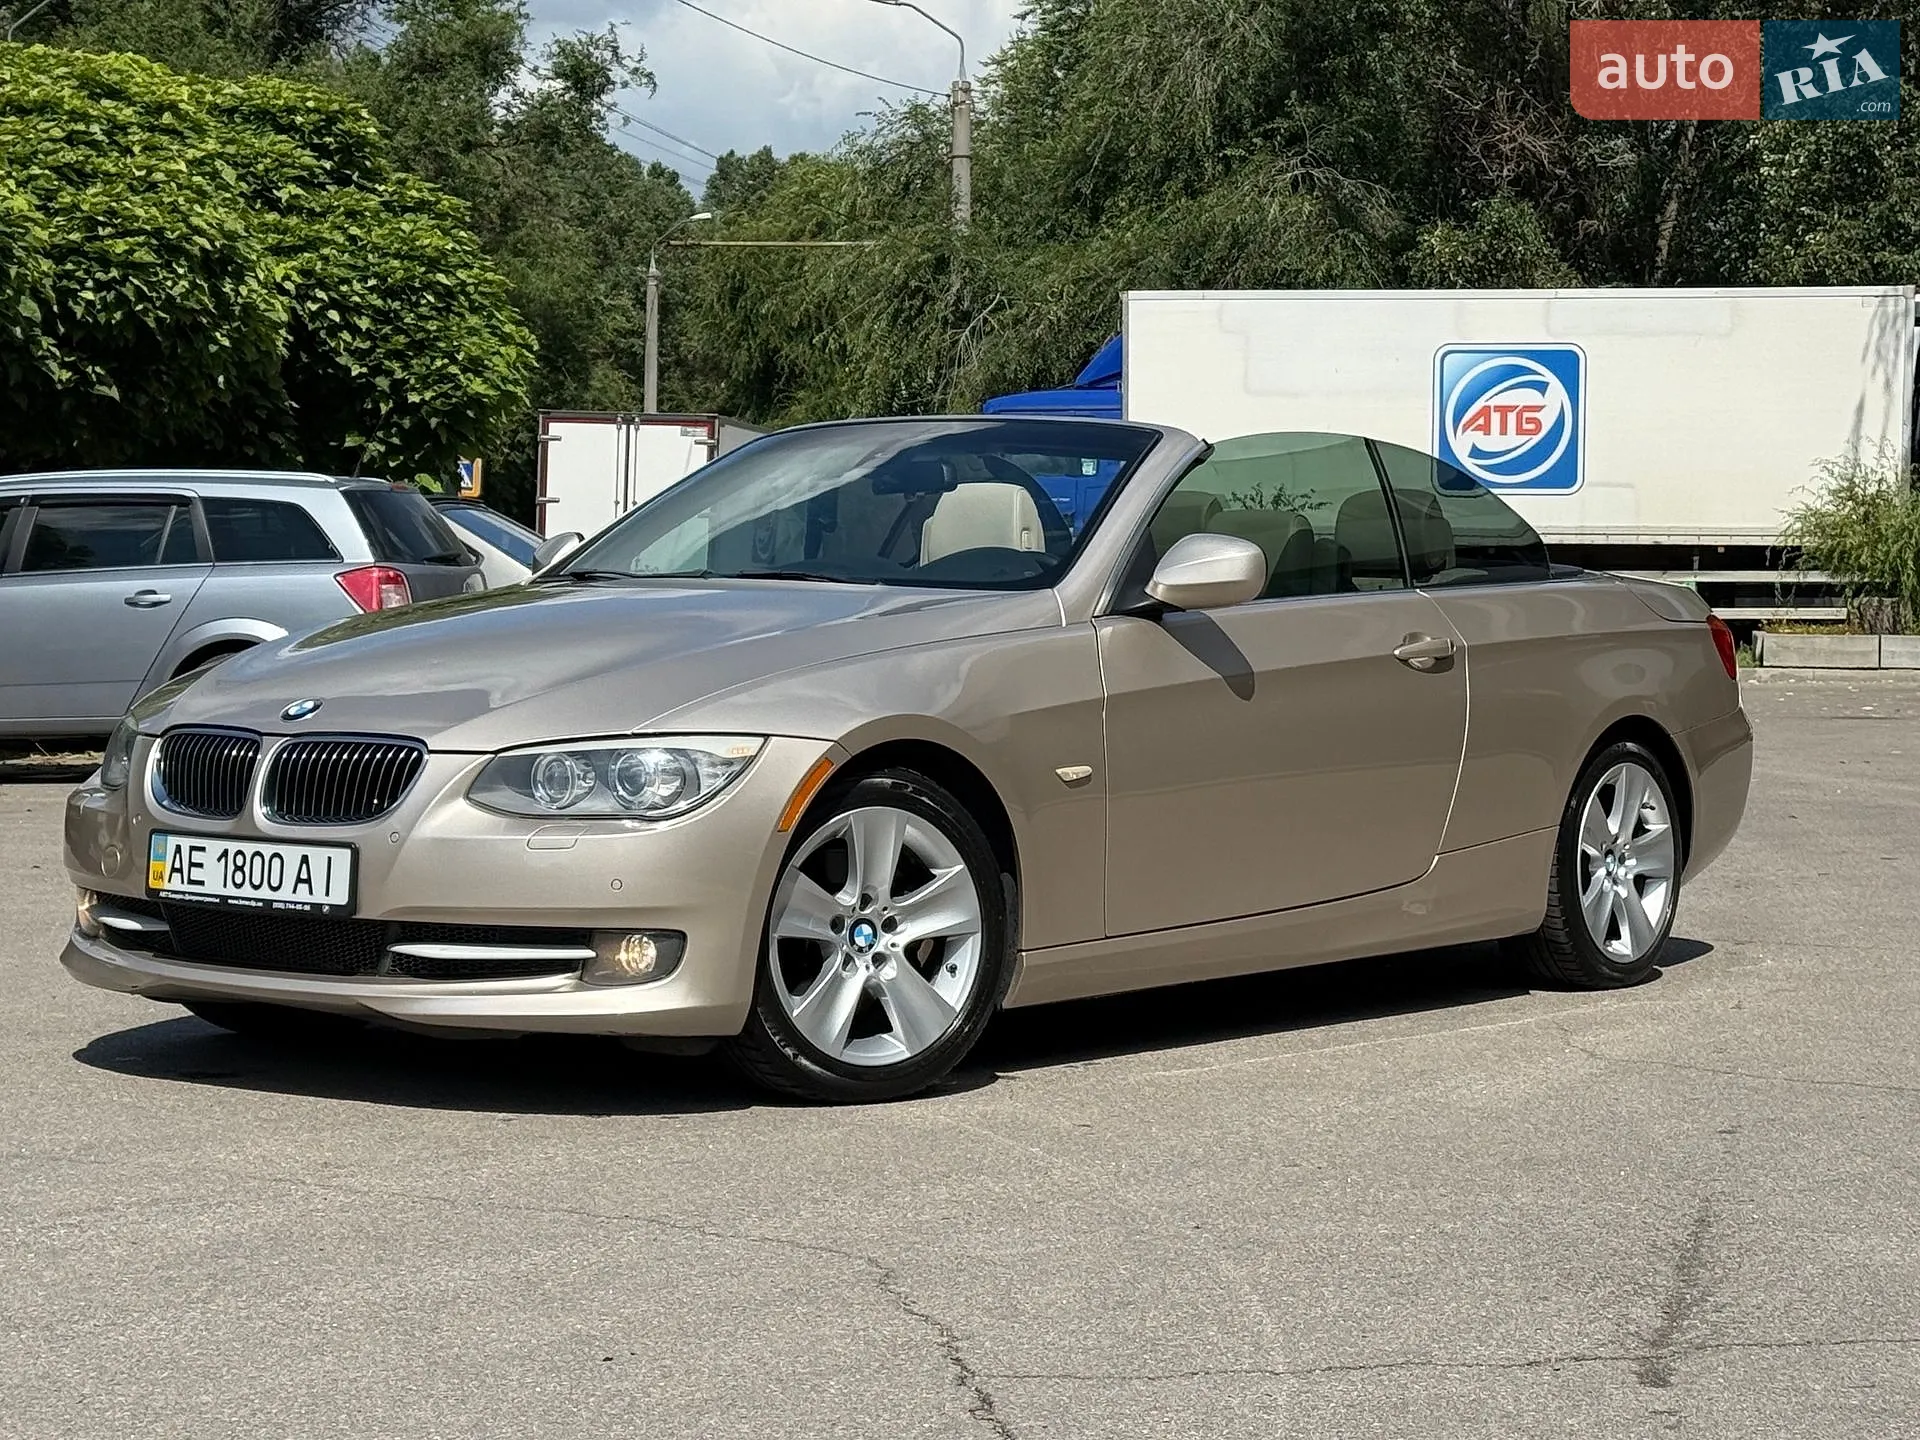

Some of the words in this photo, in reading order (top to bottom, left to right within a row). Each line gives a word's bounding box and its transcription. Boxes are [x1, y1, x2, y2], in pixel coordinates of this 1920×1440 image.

[152, 870, 164, 882] UA
[168, 844, 206, 887] AE
[216, 848, 285, 892] 1800
[292, 854, 332, 897] AI
